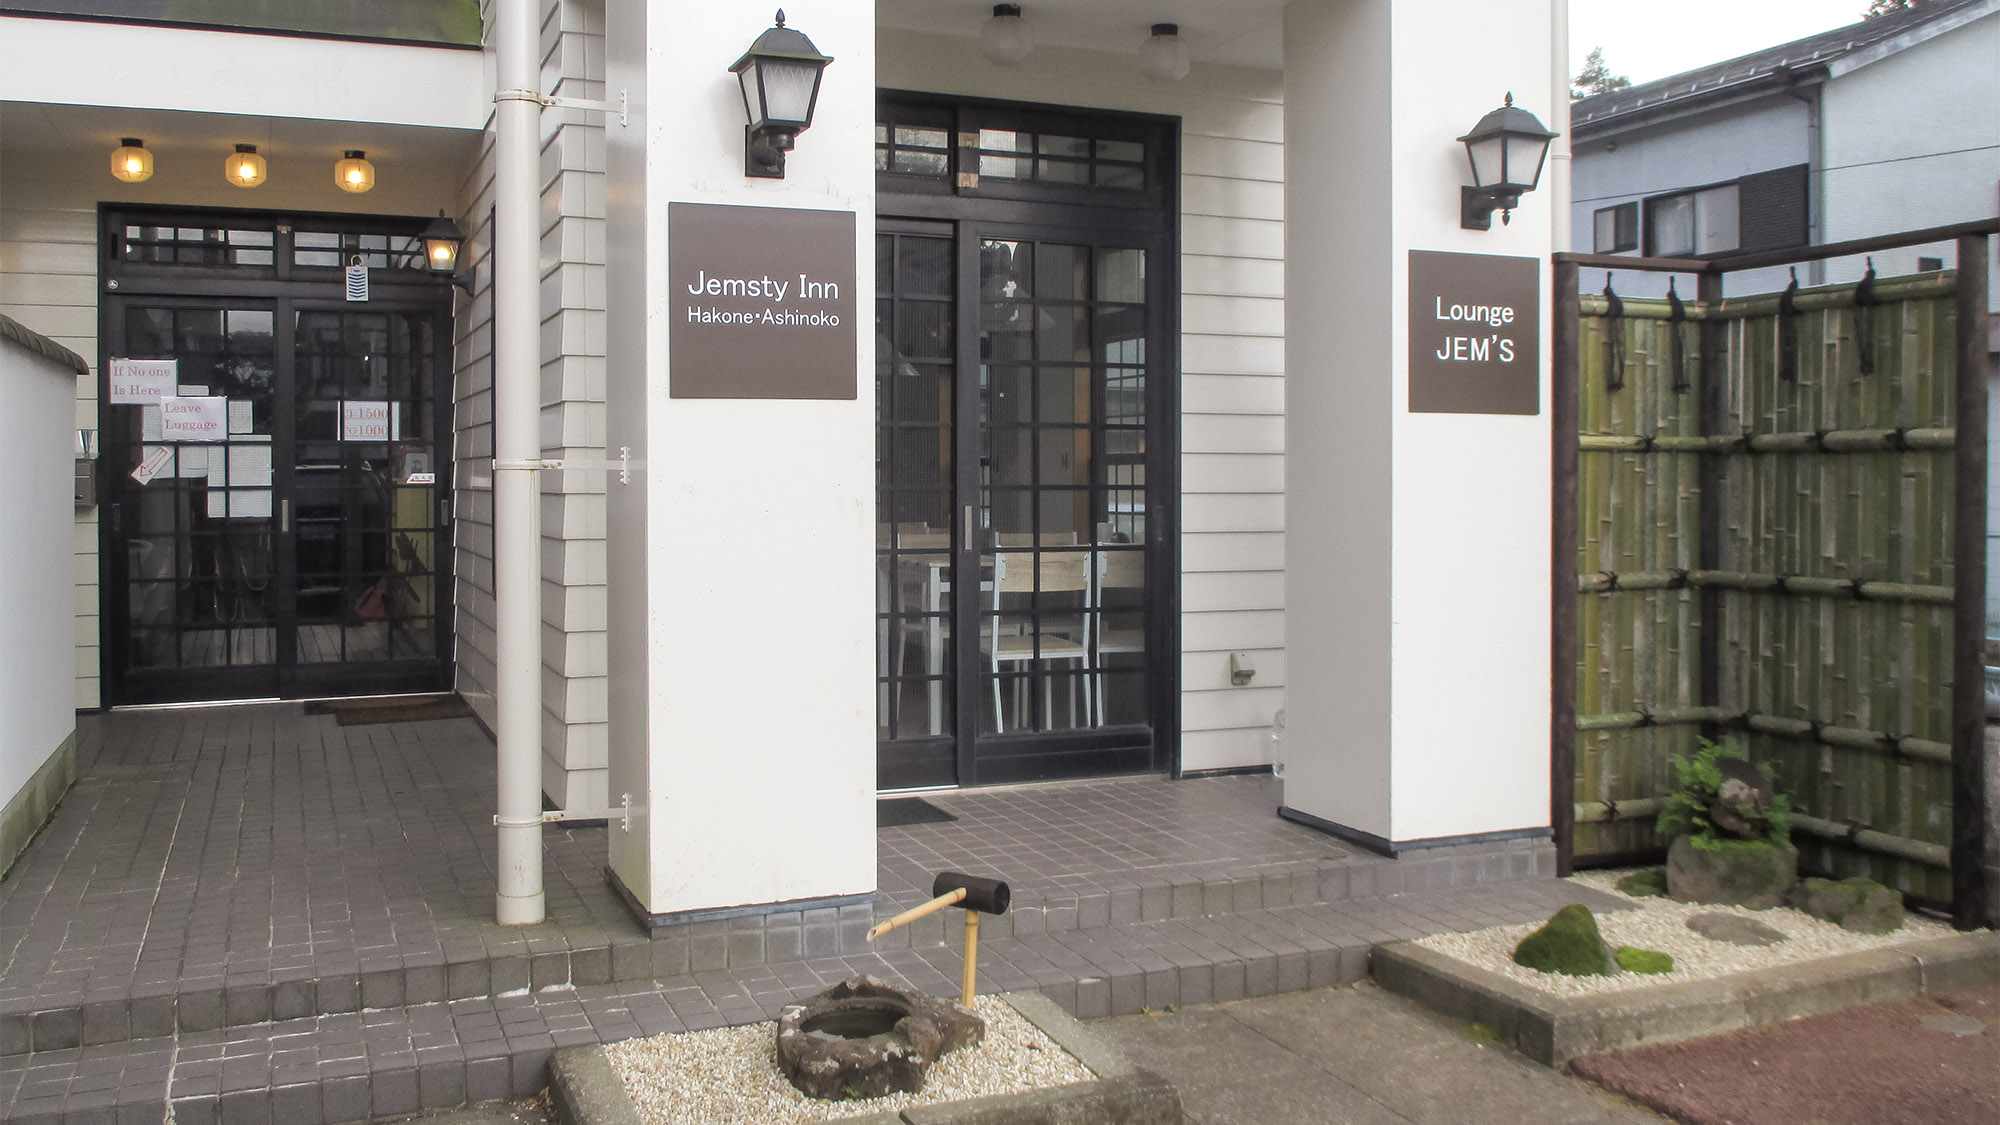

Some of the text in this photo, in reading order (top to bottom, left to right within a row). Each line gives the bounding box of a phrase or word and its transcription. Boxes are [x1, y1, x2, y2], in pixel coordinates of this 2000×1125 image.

[687, 270, 839, 302] Jemsty Inn
[1435, 295, 1515, 327] Lounge
[1436, 334, 1515, 363] JEM'S
[113, 366, 171, 377] If No one
[113, 385, 160, 395] Is Here
[165, 403, 202, 413] Leave
[165, 420, 217, 432] Luggage
